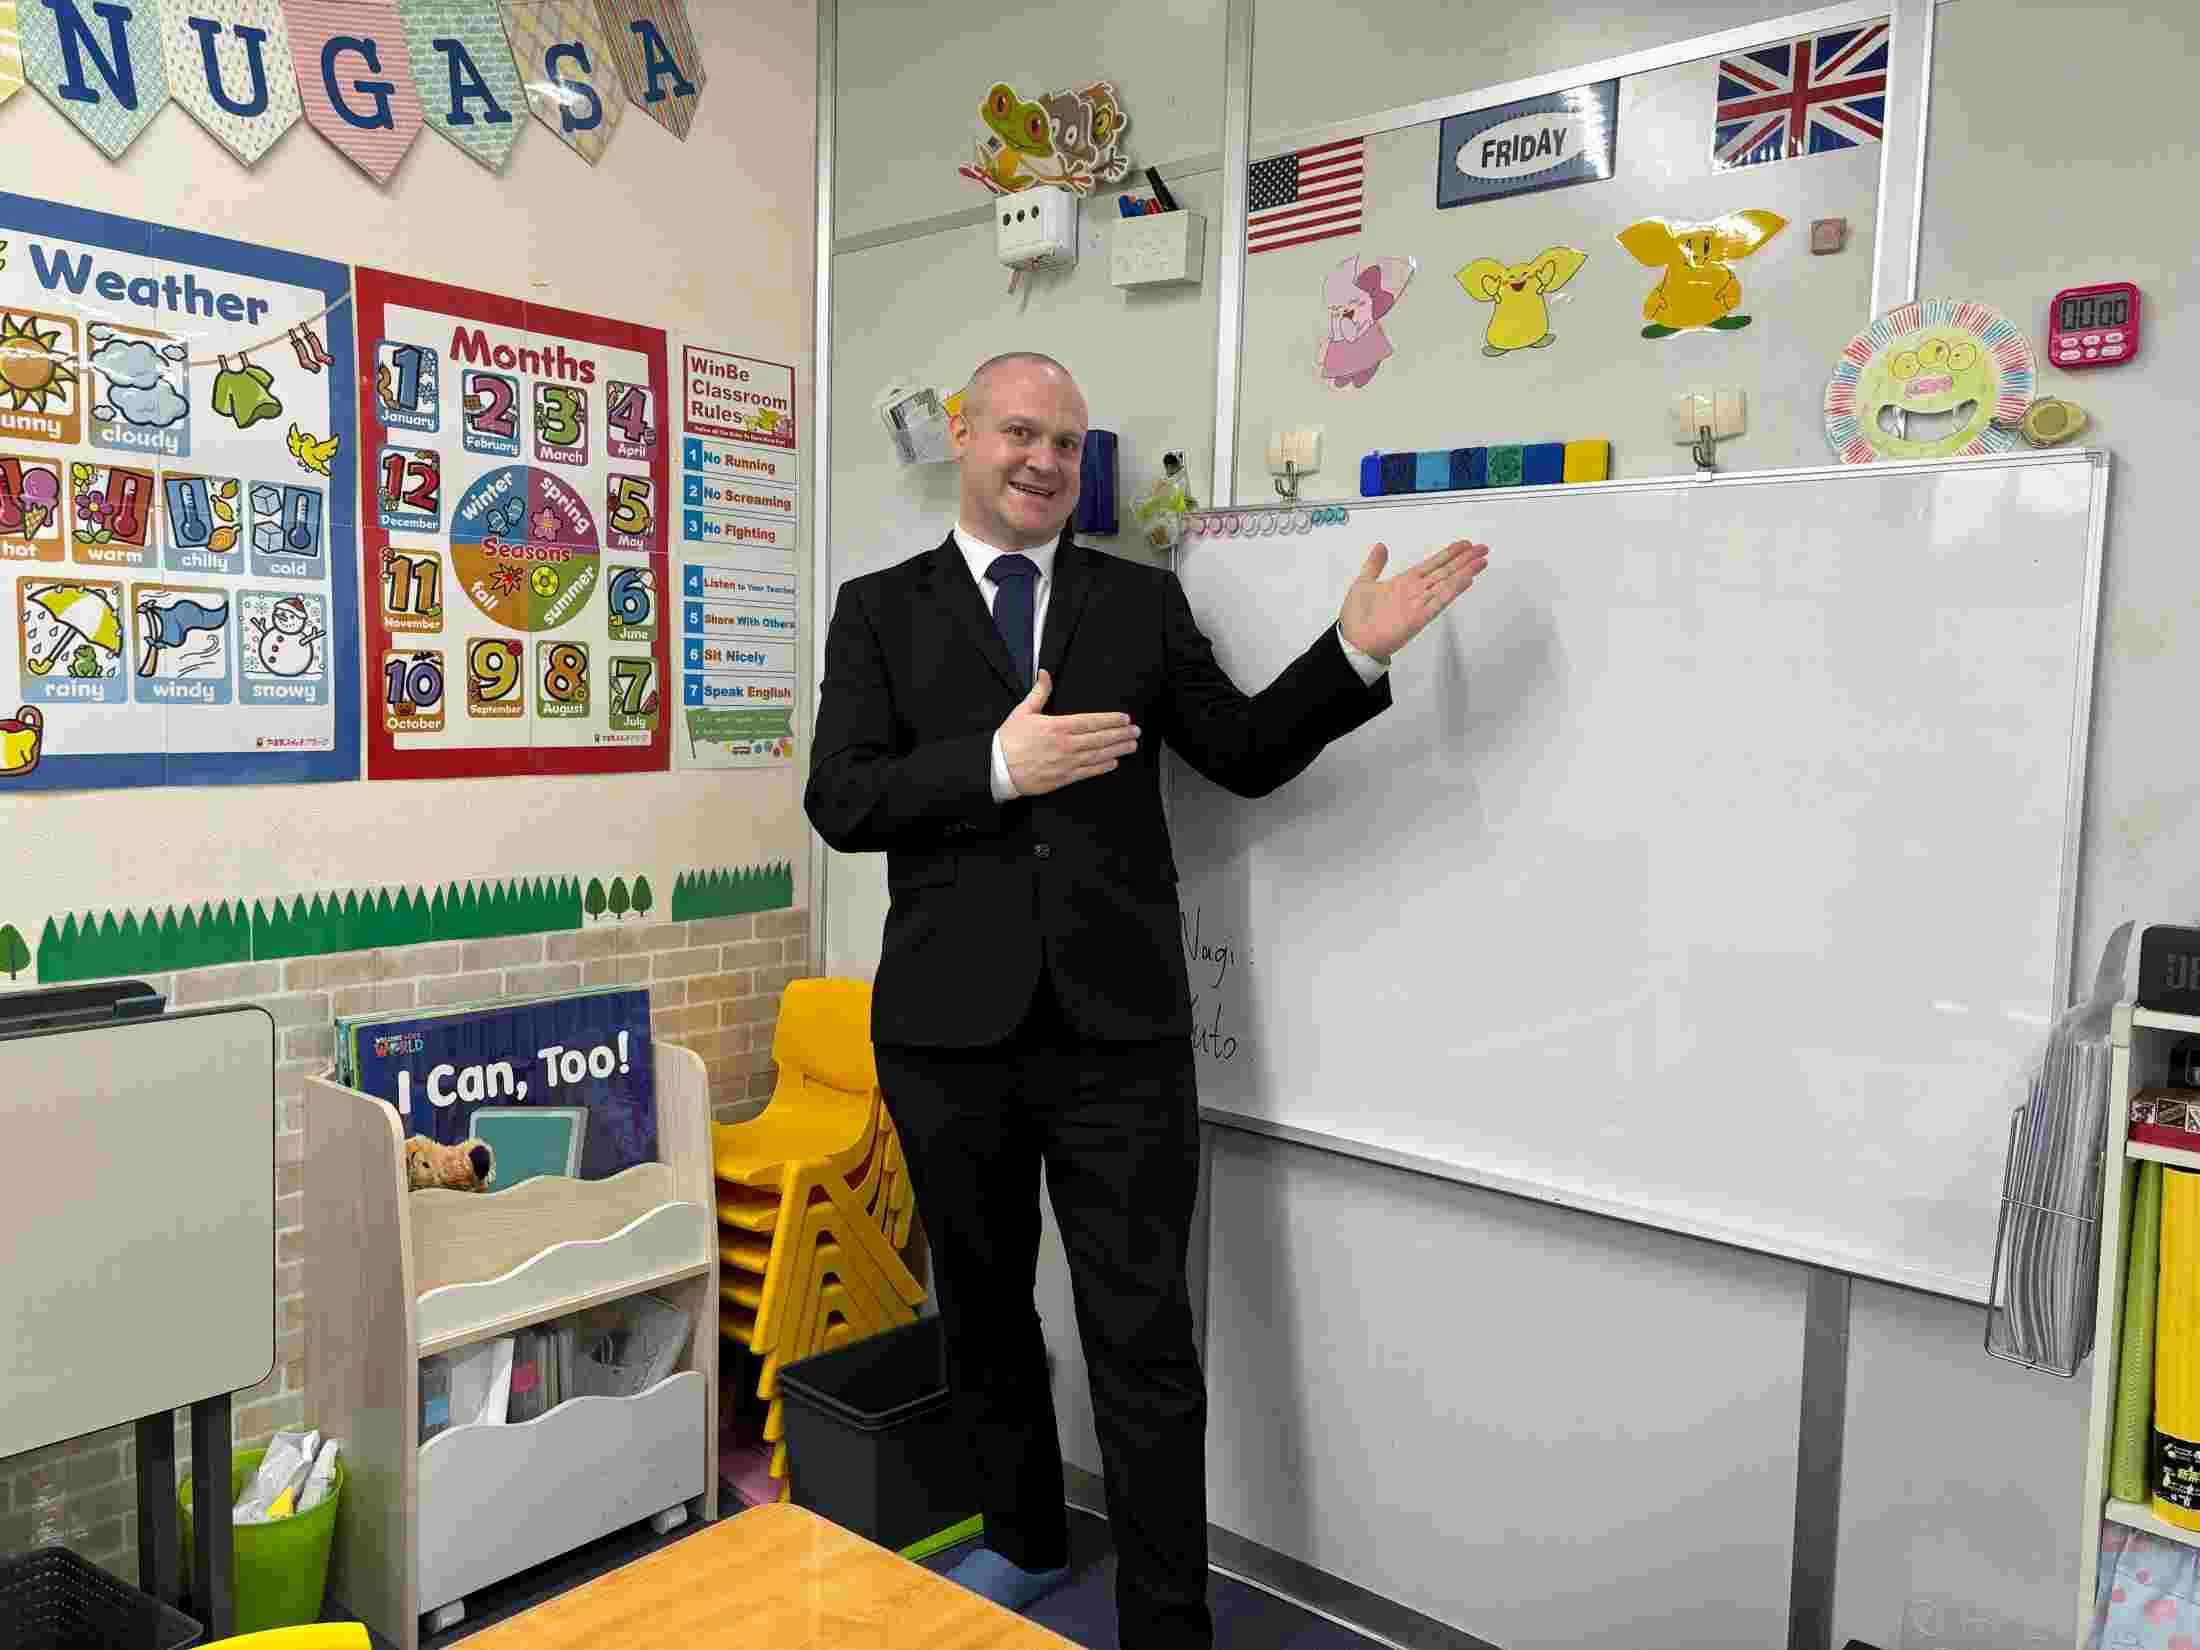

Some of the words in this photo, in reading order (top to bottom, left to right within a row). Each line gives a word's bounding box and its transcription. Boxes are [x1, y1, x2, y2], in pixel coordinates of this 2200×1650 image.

[1481, 127, 1567, 168] FRIDAY
[29, 243, 269, 325] Weather
[450, 326, 595, 384] Months
[392, 344, 423, 411] 1
[691, 356, 750, 382] WinBe
[471, 374, 514, 437] 2
[692, 379, 787, 410] Classroom
[381, 411, 435, 428] January
[543, 386, 581, 446] 3
[609, 387, 649, 442] 4
[691, 400, 743, 424] Rules
[1, 413, 61, 438] unny
[101, 427, 178, 452] cloudy
[465, 435, 519, 457] February
[618, 443, 646, 458] April
[540, 446, 583, 464] March
[689, 448, 697, 461] 1
[704, 450, 720, 465] No
[725, 454, 776, 476] Running
[383, 452, 440, 513] 12
[461, 471, 514, 523] winter
[540, 477, 591, 535] spring
[611, 476, 650, 535] 5
[688, 485, 698, 498] 2
[704, 486, 720, 501] No
[725, 489, 791, 511] Screaming
[380, 514, 439, 530] December
[689, 519, 698, 532] 3
[704, 520, 720, 535] No
[725, 524, 776, 544] Fighting
[3, 540, 39, 558] hot
[481, 536, 570, 562] Seasons
[618, 535, 644, 550] May
[88, 548, 142, 564] warm
[181, 553, 227, 571] chilly
[270, 561, 306, 576] cold
[389, 556, 437, 614] 11
[471, 580, 499, 610] fall
[543, 565, 594, 625] summer
[689, 576, 698, 587] 4
[704, 576, 736, 589] Listen
[608, 568, 650, 625] 6
[384, 616, 441, 629] November
[689, 611, 698, 625] 5
[704, 614, 736, 625] Share
[736, 615, 760, 625] With
[762, 616, 796, 629] Others
[619, 627, 648, 641] June
[689, 648, 698, 660] 6
[704, 648, 721, 661] Sit
[726, 650, 766, 666] Nicely
[385, 659, 443, 706] 10
[471, 639, 519, 702] 9
[544, 643, 588, 701] 8
[45, 683, 104, 701] rainy
[153, 683, 215, 701] windy
[252, 684, 316, 701] snowy
[616, 659, 651, 714] 7
[689, 684, 698, 697] 7
[704, 685, 744, 700] Speak
[747, 687, 791, 701] English
[470, 703, 522, 716] September
[543, 703, 584, 719] August
[387, 717, 441, 730] October
[623, 716, 646, 730] July
[398, 1070, 411, 1115] I
[427, 1060, 528, 1107] Can,
[537, 1031, 631, 1088] Too!
